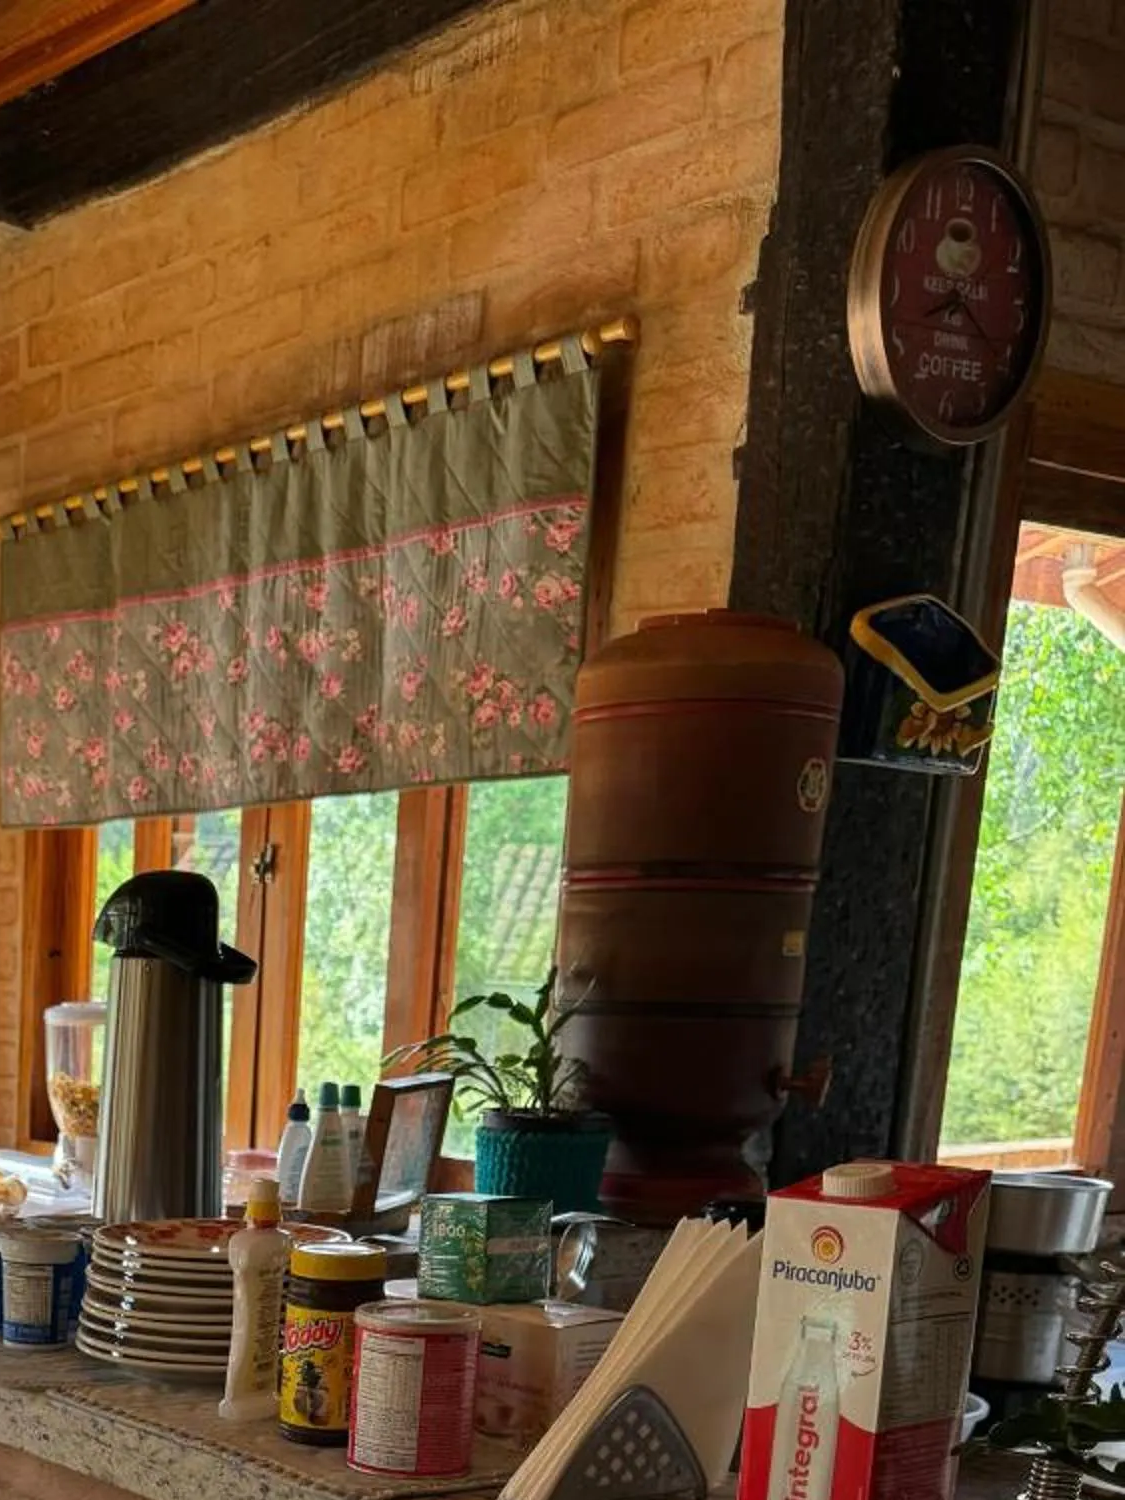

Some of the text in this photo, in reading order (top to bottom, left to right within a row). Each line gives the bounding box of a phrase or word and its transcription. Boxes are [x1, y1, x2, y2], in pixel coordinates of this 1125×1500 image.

[925, 180, 943, 221] 11
[918, 351, 983, 382] COFFEE
[772, 1258, 879, 1294] Piracanjuba
[848, 1330, 873, 1352] 3%
